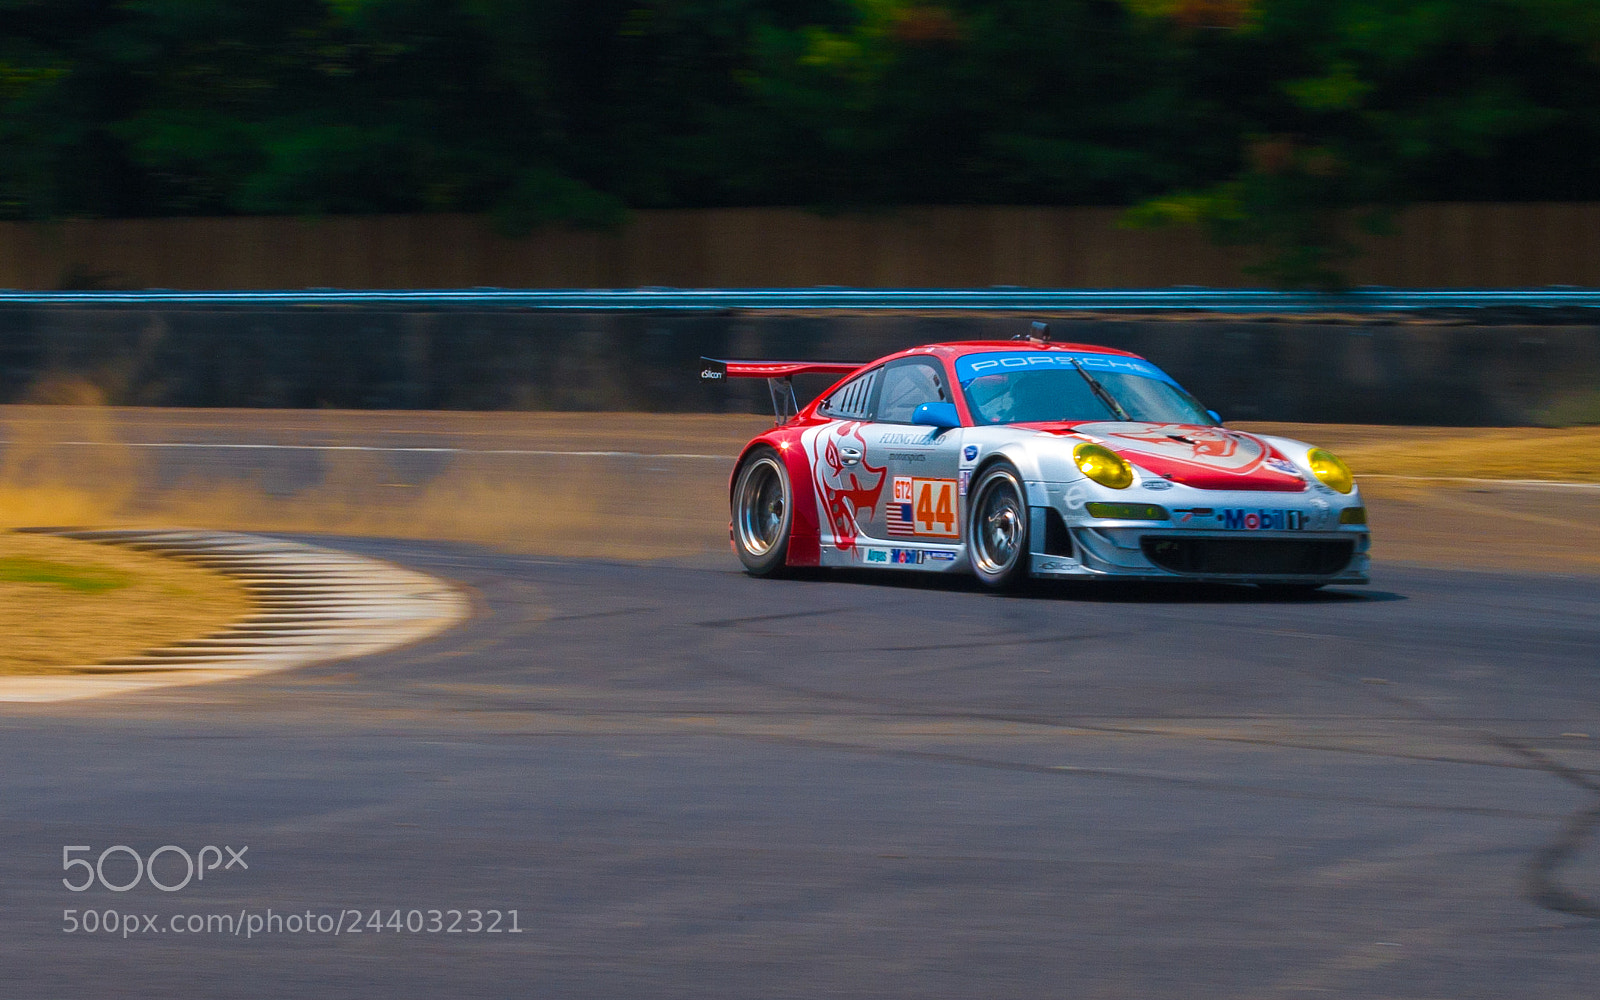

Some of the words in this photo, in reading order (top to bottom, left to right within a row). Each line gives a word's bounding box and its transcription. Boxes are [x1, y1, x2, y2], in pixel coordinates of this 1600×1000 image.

[879, 432, 912, 445] FLYING
[895, 480, 911, 500] GT2
[916, 483, 955, 533] 44
[1224, 508, 1285, 530] Mobil
[1288, 509, 1302, 530] 1
